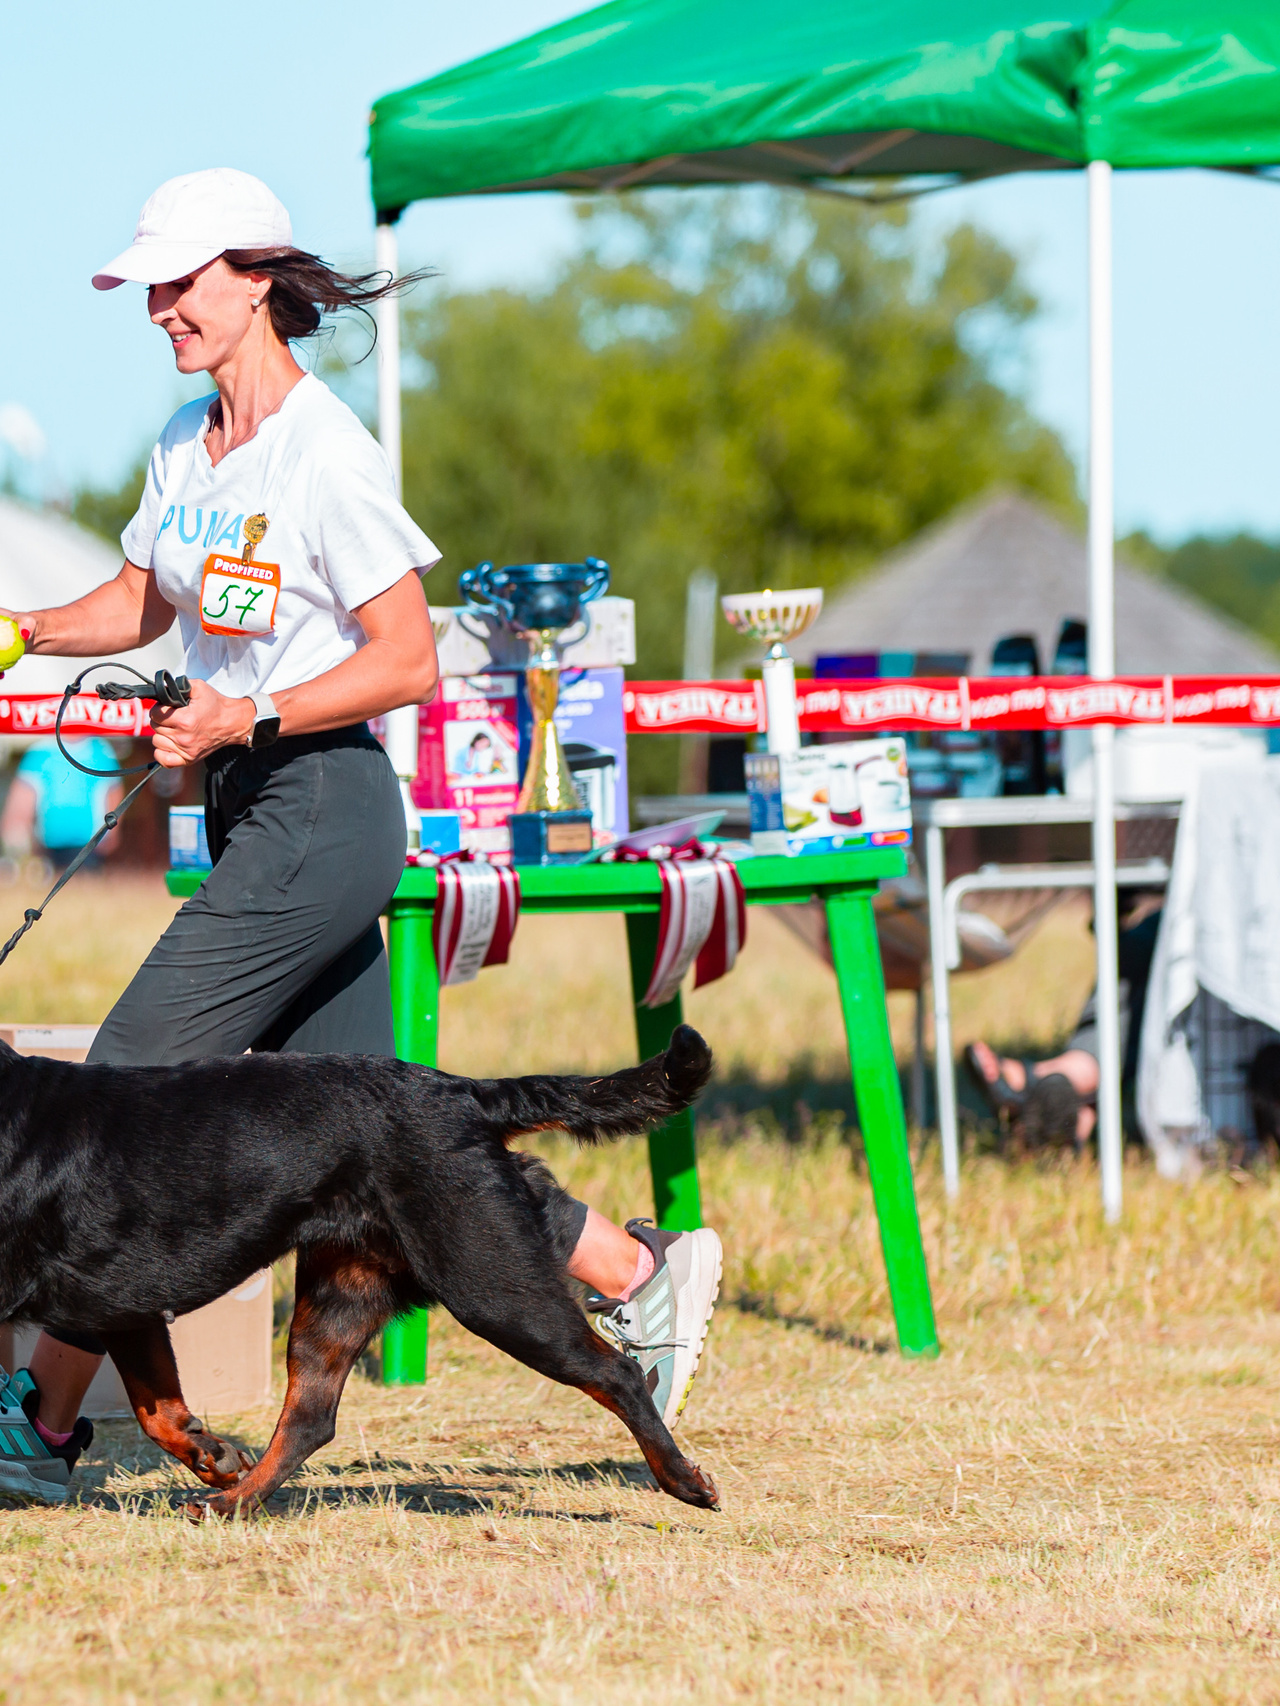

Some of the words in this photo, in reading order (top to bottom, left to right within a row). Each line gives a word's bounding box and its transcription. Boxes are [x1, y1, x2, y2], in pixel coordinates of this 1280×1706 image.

[214, 558, 273, 580] PROFIFEED
[202, 584, 264, 625] 57
[638, 692, 756, 721] ТРАПЕЗА
[842, 688, 961, 720] ТРАПЕЗА
[1051, 685, 1164, 719] ТРАПЕЗА
